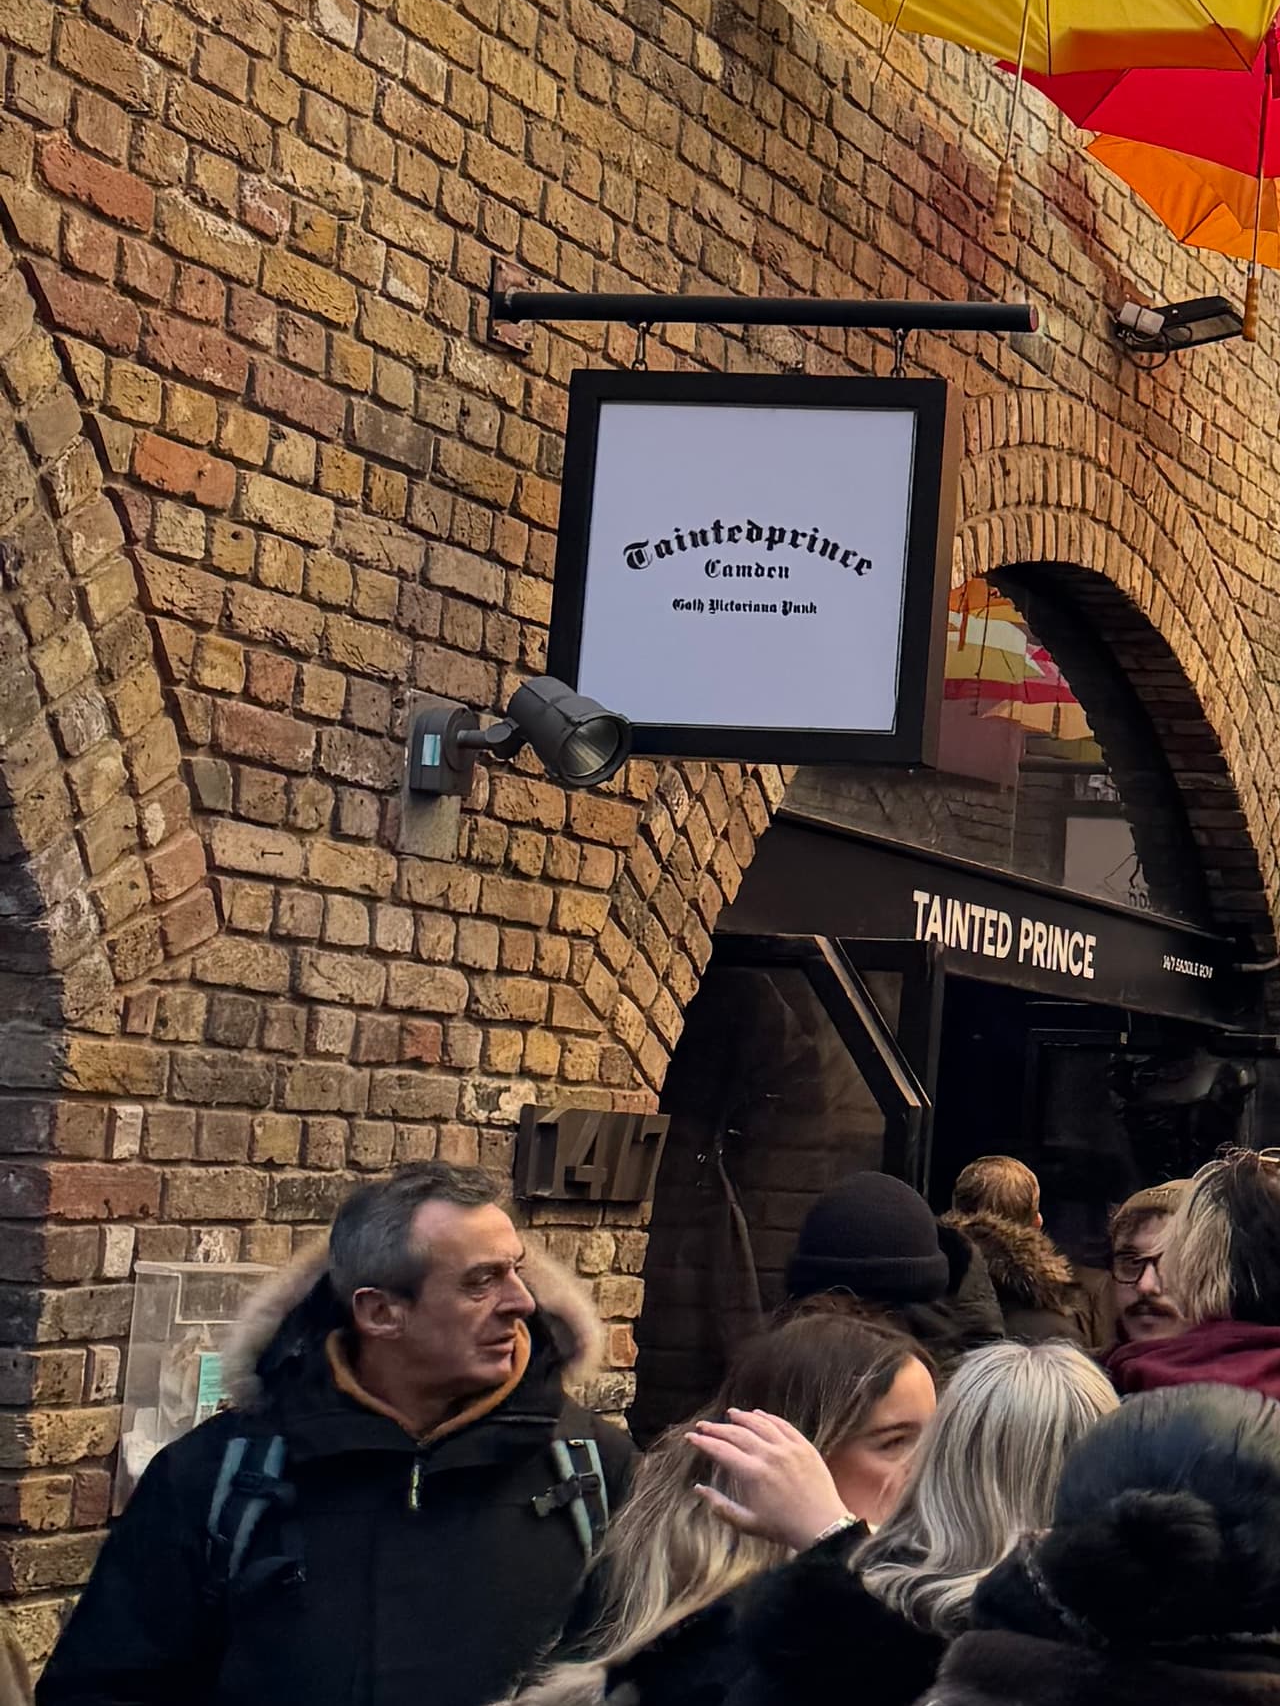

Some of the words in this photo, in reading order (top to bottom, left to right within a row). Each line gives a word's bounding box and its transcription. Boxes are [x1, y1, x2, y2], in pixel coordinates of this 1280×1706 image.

[623, 519, 872, 577] Taintedprince
[704, 558, 790, 579] Camden
[708, 599, 777, 614] Victoriana
[782, 600, 817, 616] Punk
[913, 890, 1012, 959] TAINTED
[1018, 918, 1096, 979] PRINCE
